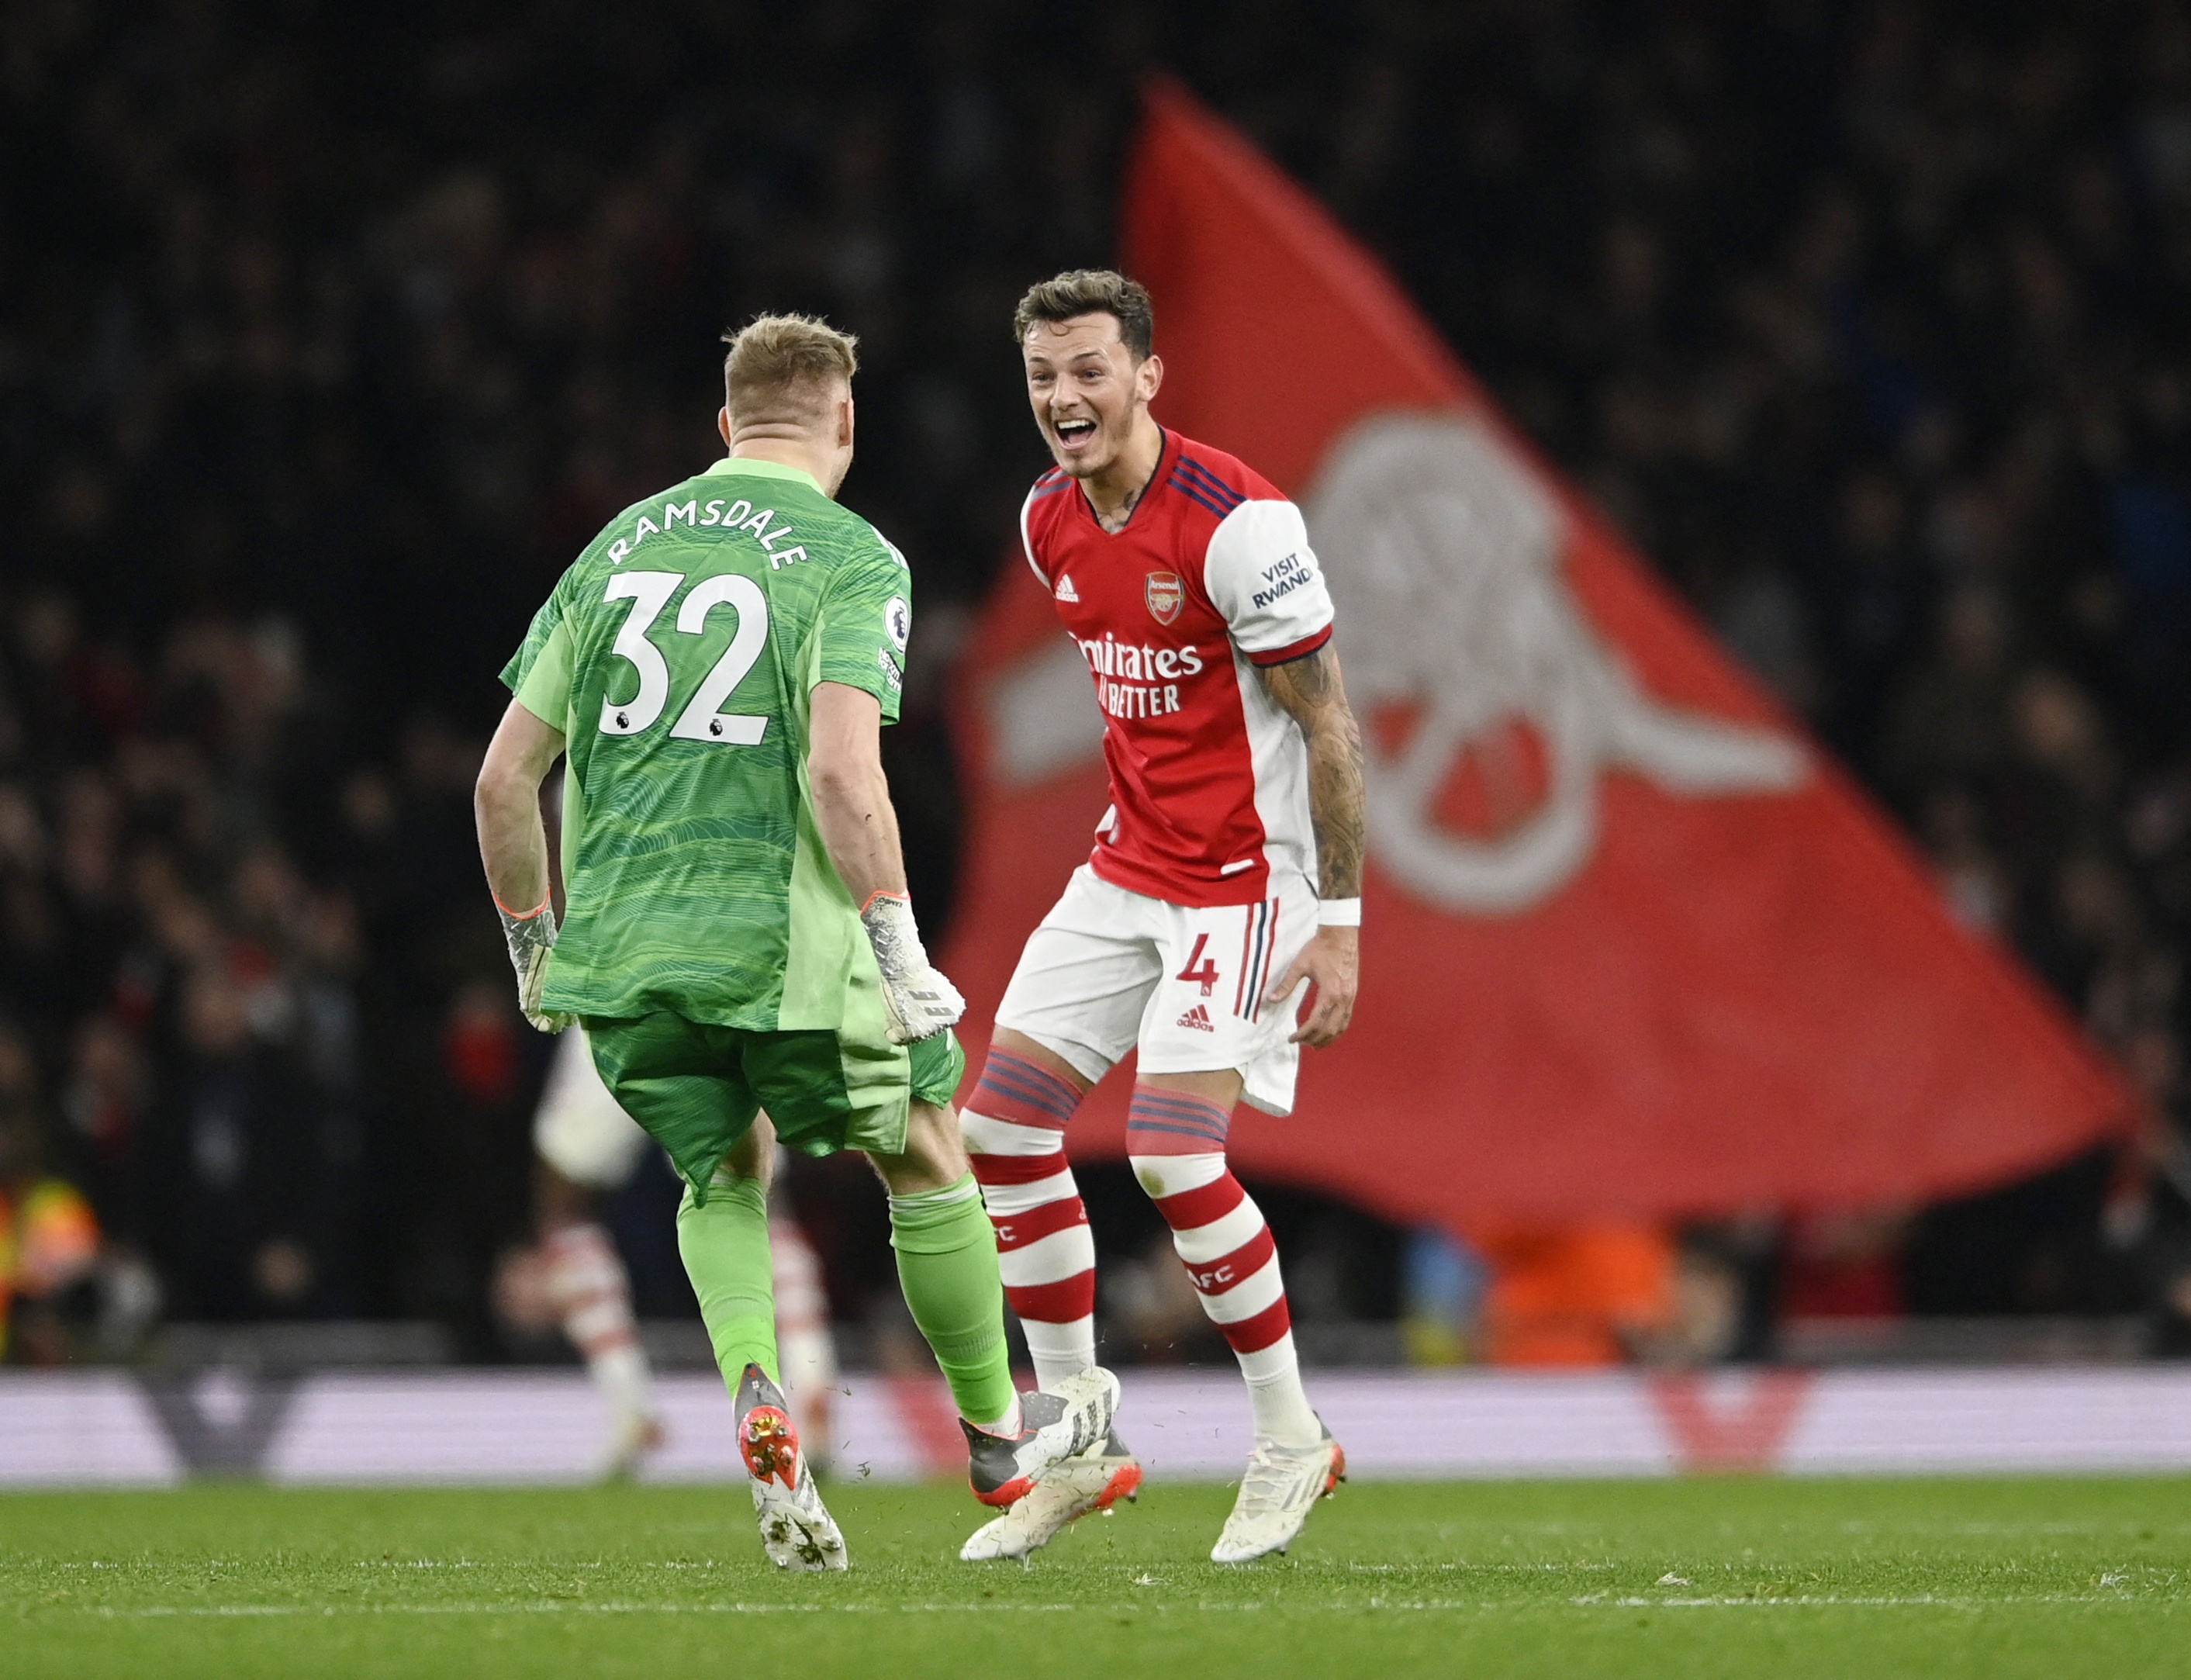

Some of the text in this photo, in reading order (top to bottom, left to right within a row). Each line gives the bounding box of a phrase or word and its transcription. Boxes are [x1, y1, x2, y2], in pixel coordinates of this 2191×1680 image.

[606, 500, 807, 570] RAMSDALE
[1150, 579, 1180, 589] Arsenal
[1252, 564, 1313, 610] RWAND
[1261, 552, 1299, 583] VISIT
[598, 570, 769, 745] 32
[1067, 631, 1203, 681] mirates
[1108, 683, 1180, 719] BETTER
[1176, 932, 1220, 997] 4
[1177, 1018, 1214, 1032] adidas
